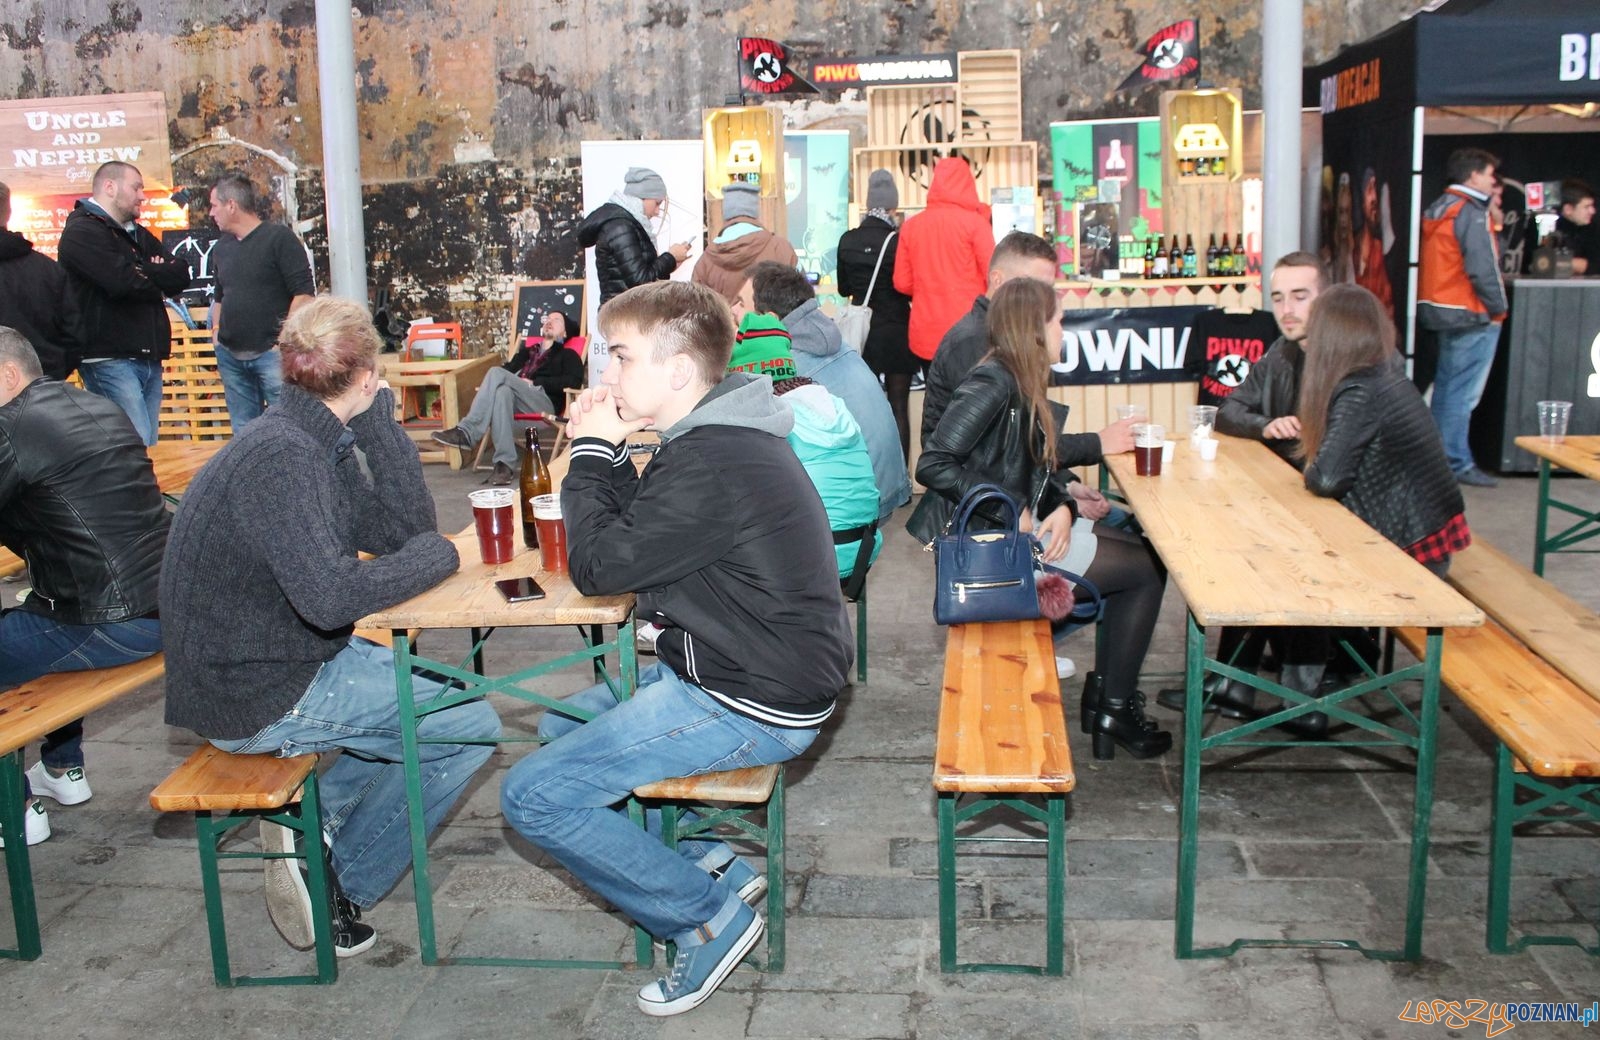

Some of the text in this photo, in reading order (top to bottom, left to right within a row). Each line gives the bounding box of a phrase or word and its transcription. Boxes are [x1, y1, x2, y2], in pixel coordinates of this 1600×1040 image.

[1147, 19, 1194, 52] PIWO
[742, 38, 785, 60] PIWO
[24, 110, 127, 131] UNCLE
[52, 131, 101, 146] AND
[13, 145, 142, 168] NEPHEW
[1206, 336, 1264, 363] PIWO
[761, 358, 794, 370] HOT
